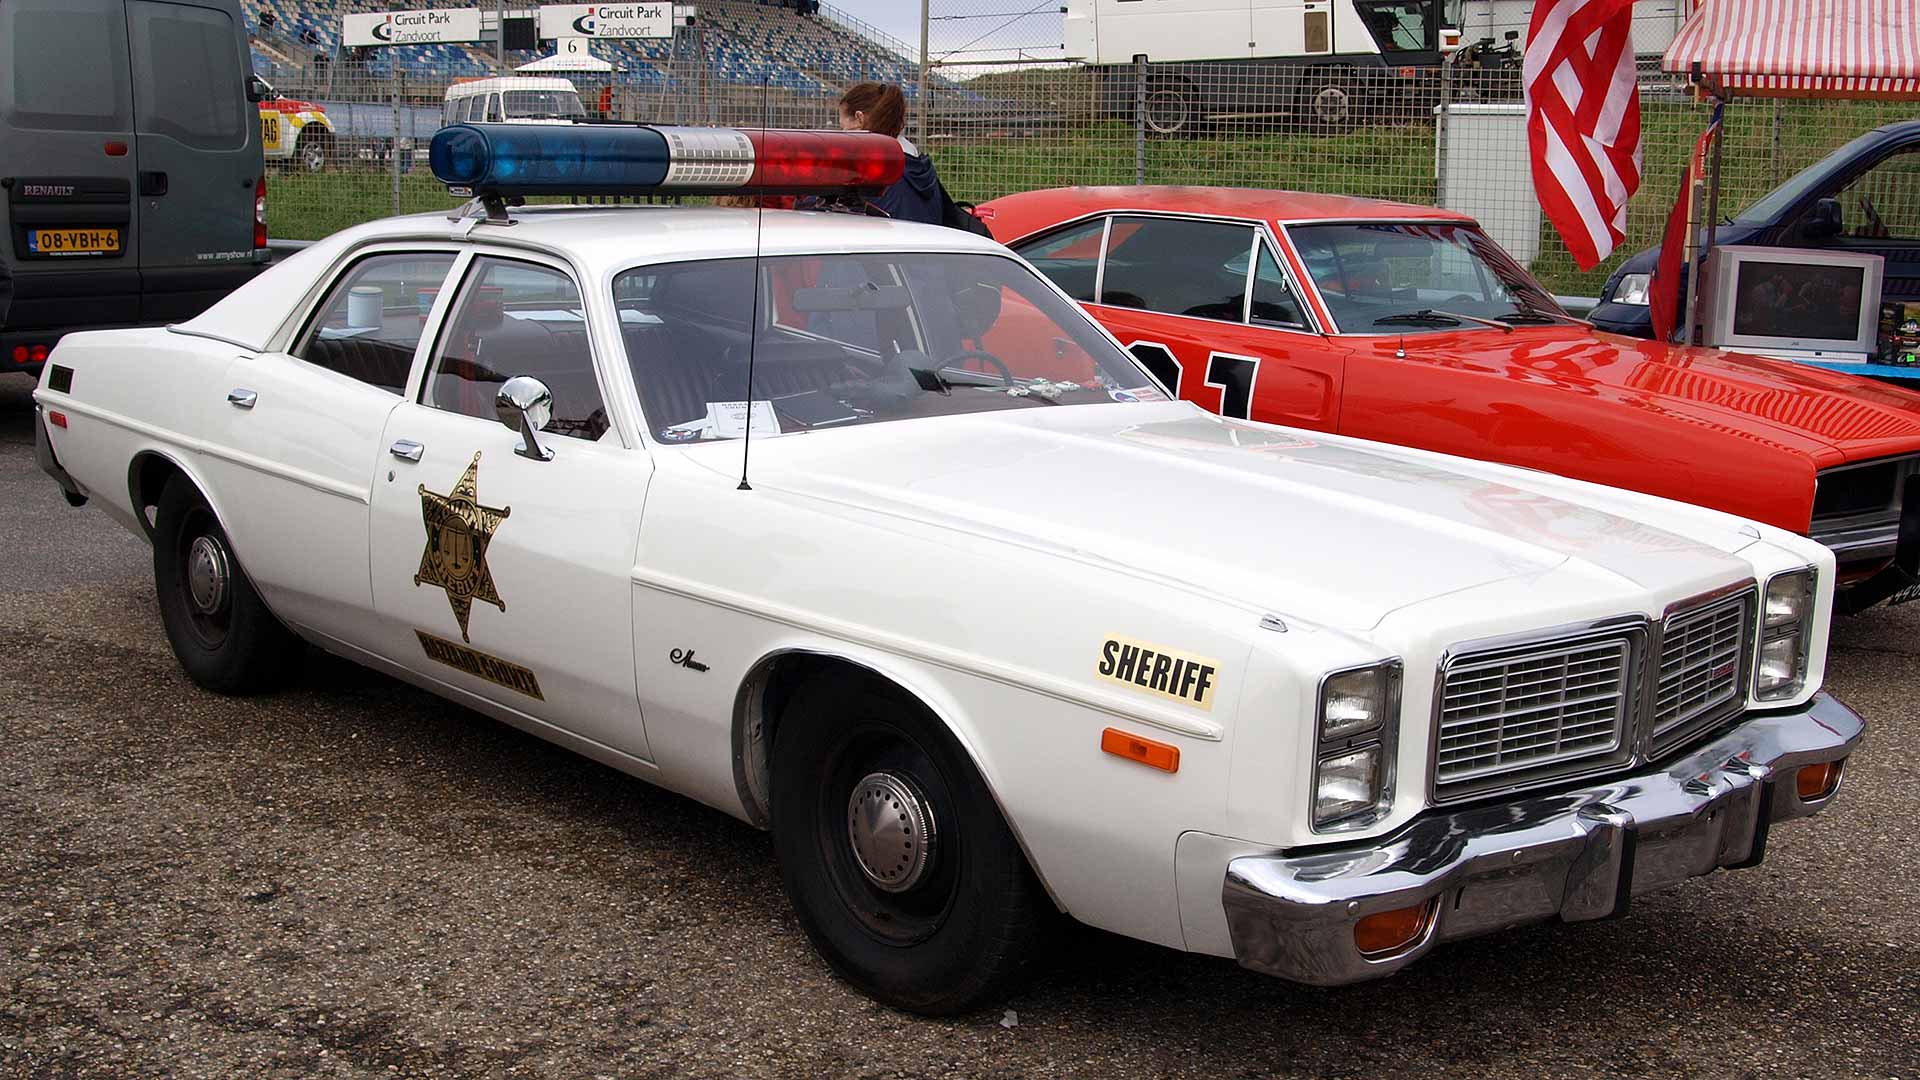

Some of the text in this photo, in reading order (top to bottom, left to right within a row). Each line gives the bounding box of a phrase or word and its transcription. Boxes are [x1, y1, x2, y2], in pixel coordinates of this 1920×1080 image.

[394, 12, 450, 26] Circuit Park
[599, 6, 662, 19] Circuit Park
[395, 31, 441, 42] Zandvoort
[600, 24, 651, 36] Zandvoort
[567, 39, 577, 53] 6
[260, 118, 277, 143] AG
[24, 185, 75, 196] RENAULT
[41, 231, 115, 249] 08-VBH-6
[1098, 639, 1215, 703] SHERIFF
